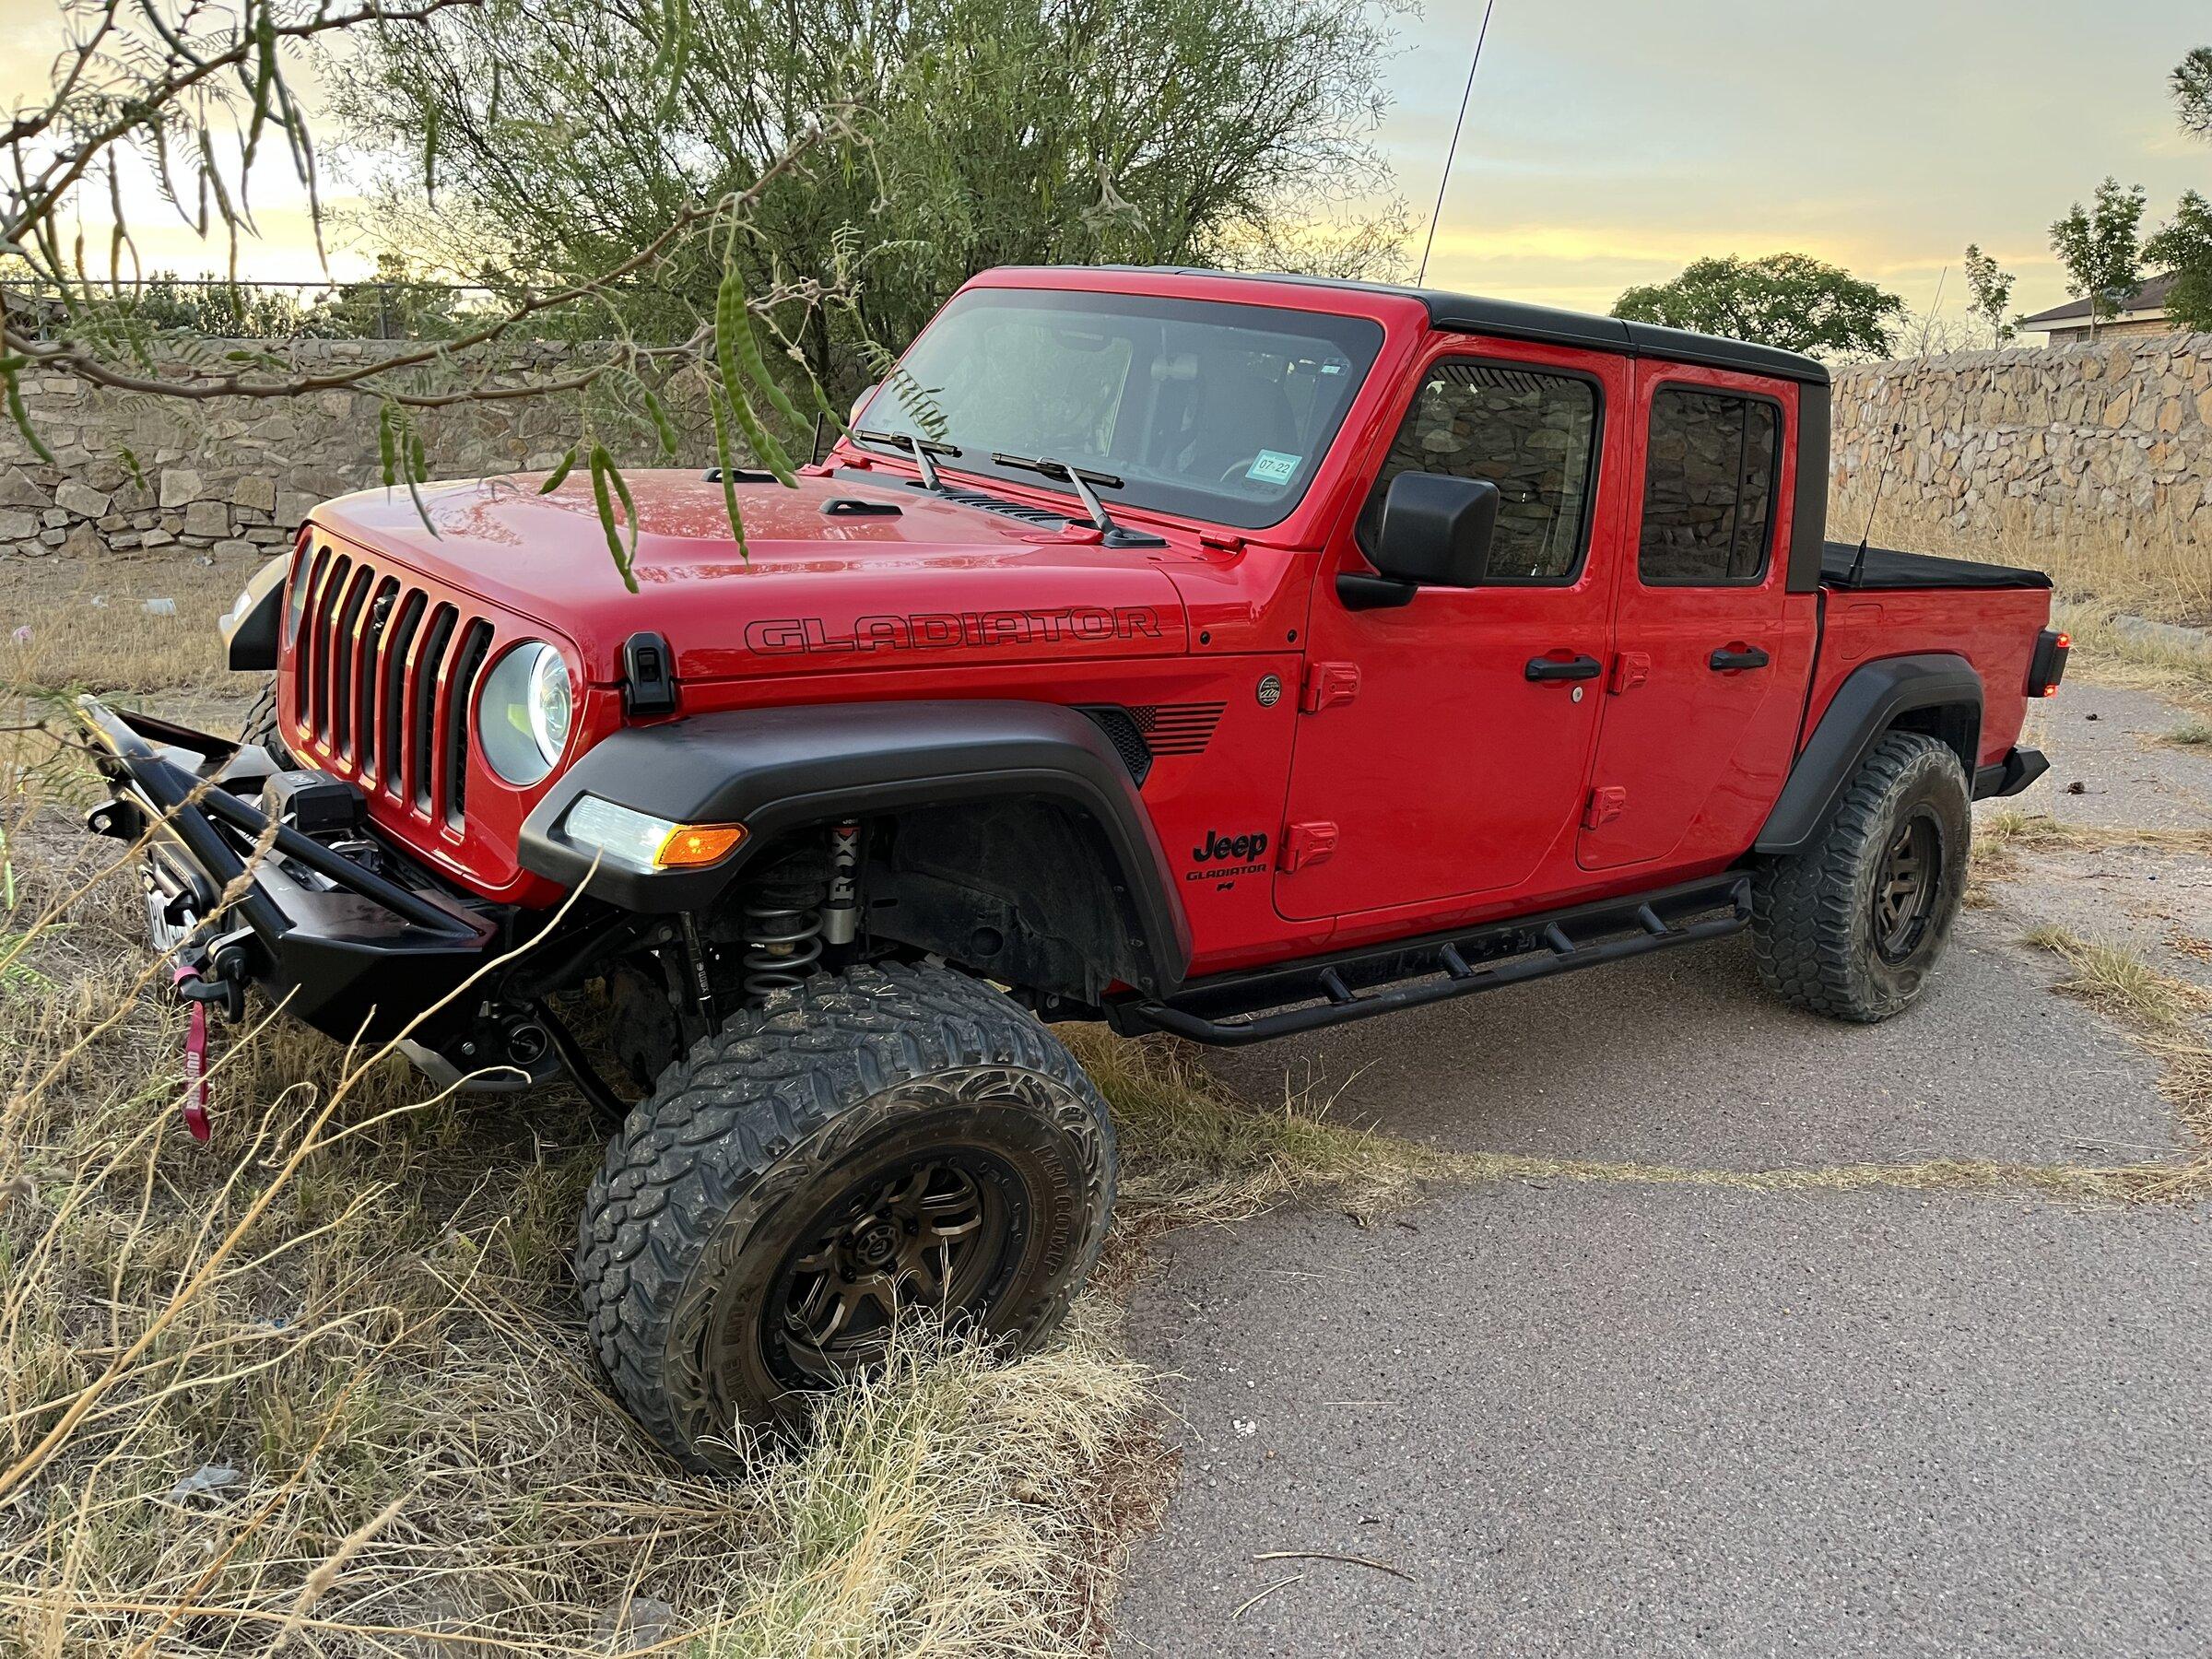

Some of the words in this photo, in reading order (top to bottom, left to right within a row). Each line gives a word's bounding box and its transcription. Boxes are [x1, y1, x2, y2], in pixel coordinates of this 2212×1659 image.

[1259, 459, 1274, 470] 07
[1275, 463, 1290, 474] 22
[743, 606, 1164, 655] GLADIATOR
[1193, 830, 1268, 863] Jeep
[1185, 863, 1267, 882] GLADIATOR
[1031, 1144, 1069, 1189] PRO
[1043, 1194, 1074, 1277] COMP
